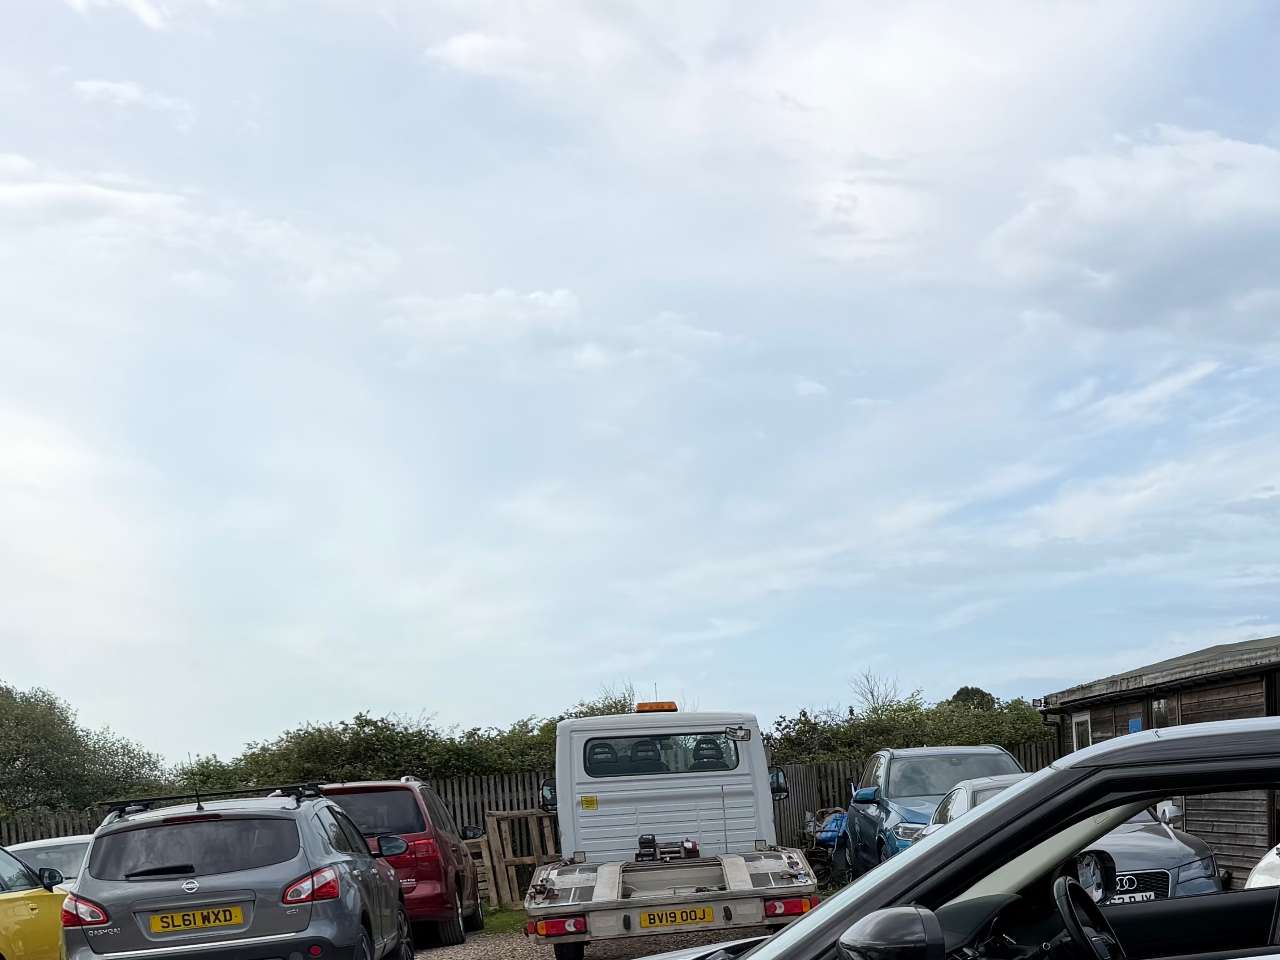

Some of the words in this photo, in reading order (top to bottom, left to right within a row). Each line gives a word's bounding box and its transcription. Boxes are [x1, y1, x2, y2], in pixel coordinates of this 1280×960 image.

[160, 913, 198, 930] SL61
[201, 908, 233, 925] WXD
[648, 911, 677, 925] BV19
